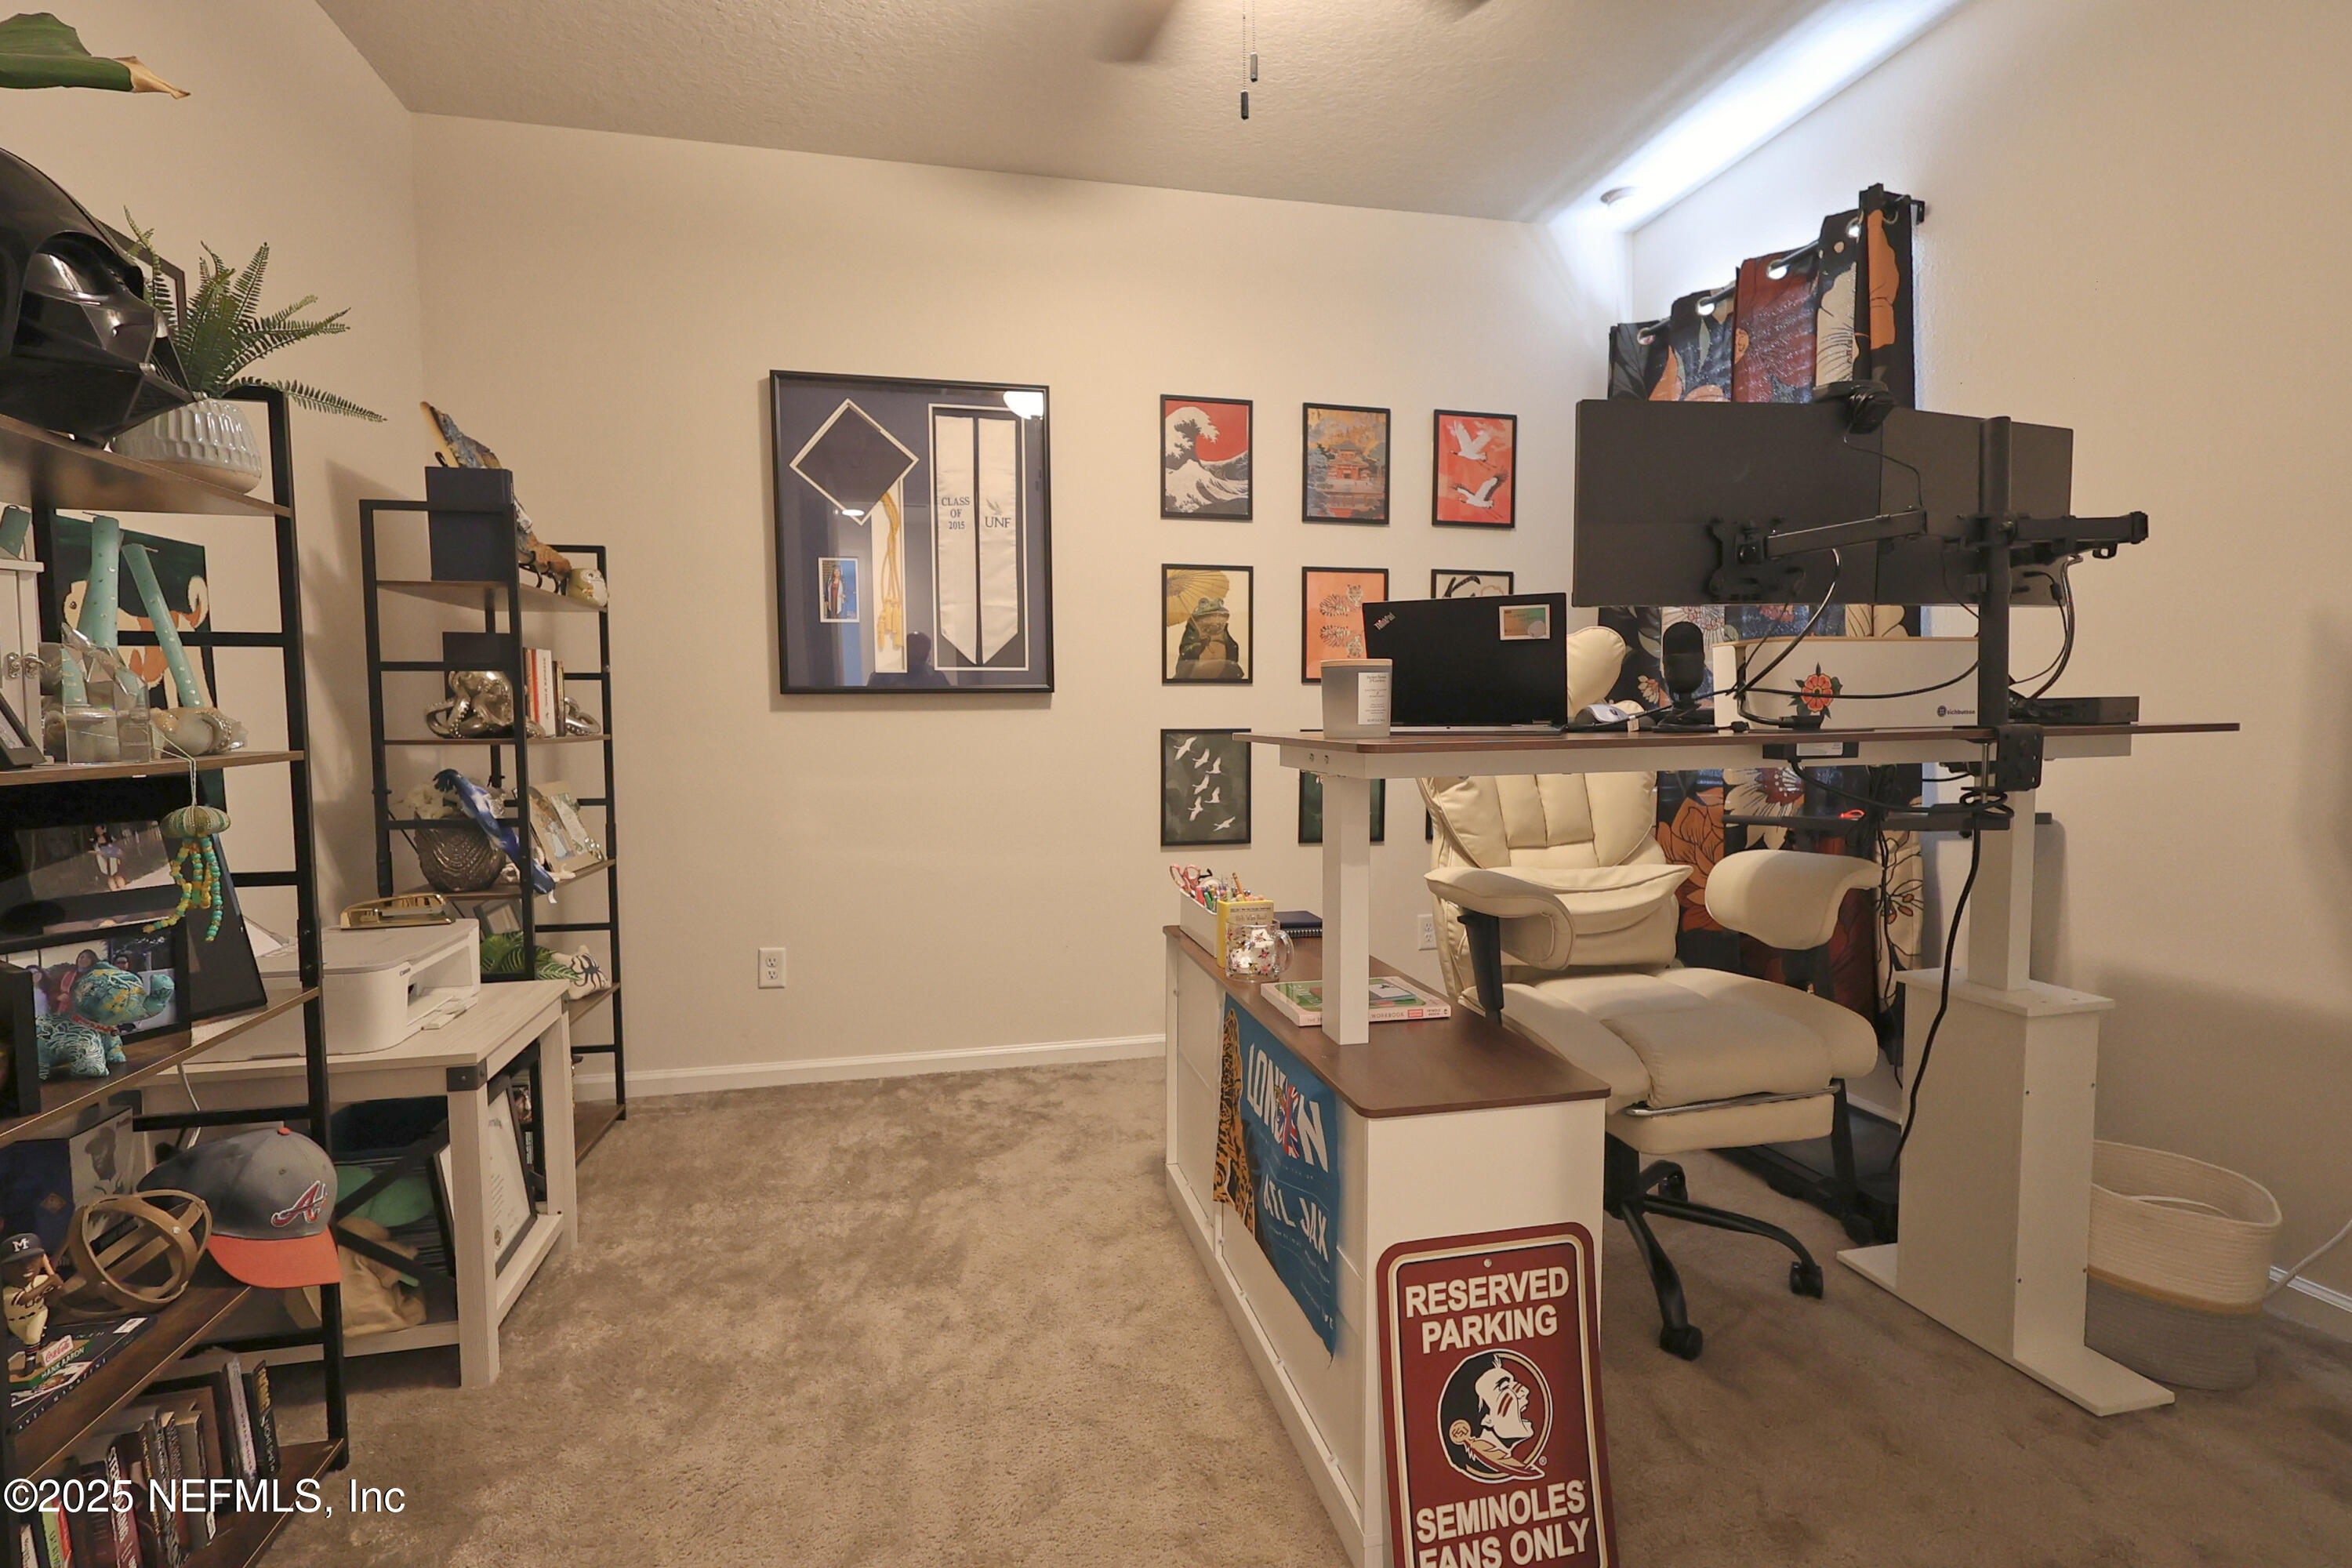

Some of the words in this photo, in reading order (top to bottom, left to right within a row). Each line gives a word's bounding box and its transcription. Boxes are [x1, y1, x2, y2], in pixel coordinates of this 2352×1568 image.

[942, 496, 970, 506] CLASS
[950, 508, 963, 518] OF
[948, 520, 966, 530] 2015
[985, 517, 1011, 528] UNF
[1374, 612, 1397, 630] ThinkPad
[1299, 1197, 1329, 1263] JAX
[12, 1238, 30, 1252] M
[1405, 1266, 1570, 1319] RESERVED
[1421, 1305, 1559, 1354] PARKING
[42, 1363, 61, 1379] HANK
[61, 1347, 85, 1367] AARON
[1416, 1479, 1587, 1544] SEMINOLES
[1418, 1536, 1502, 1568] FANS
[1510, 1517, 1590, 1566] ONLY
